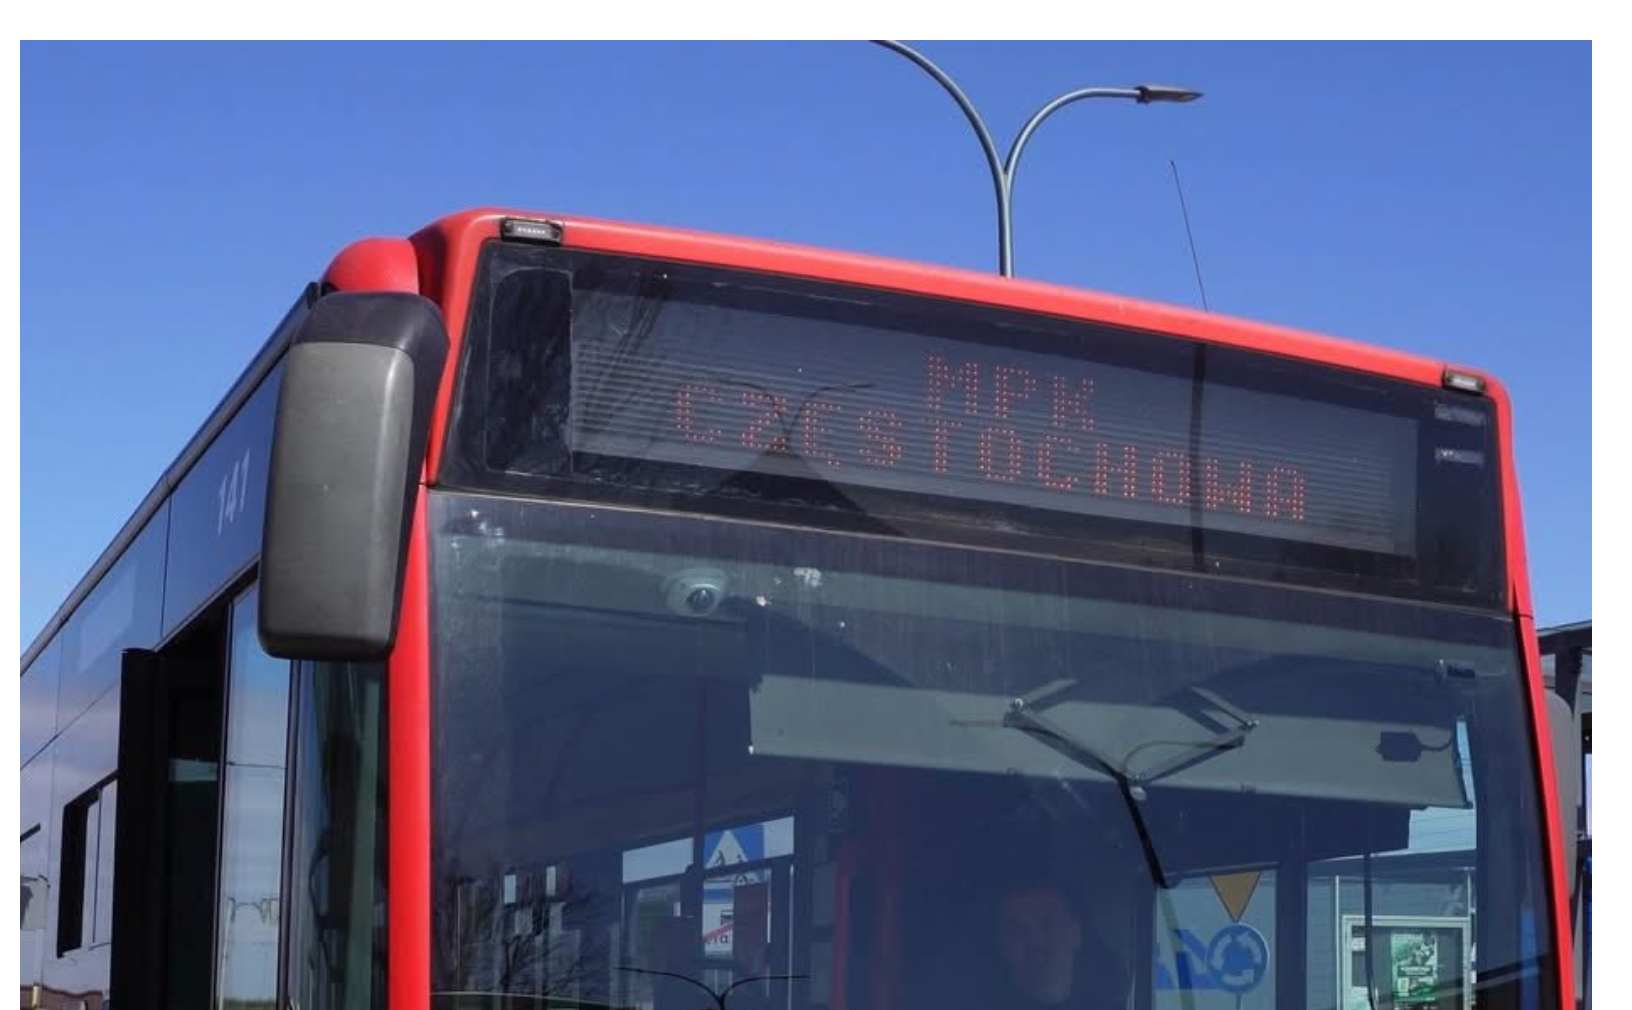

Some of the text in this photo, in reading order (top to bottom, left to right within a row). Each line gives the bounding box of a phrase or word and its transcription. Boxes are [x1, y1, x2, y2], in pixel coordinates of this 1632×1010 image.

[926, 354, 1095, 432] MPK
[217, 448, 250, 536] 141
[675, 381, 1305, 521] CZĘSTOCHOWA
